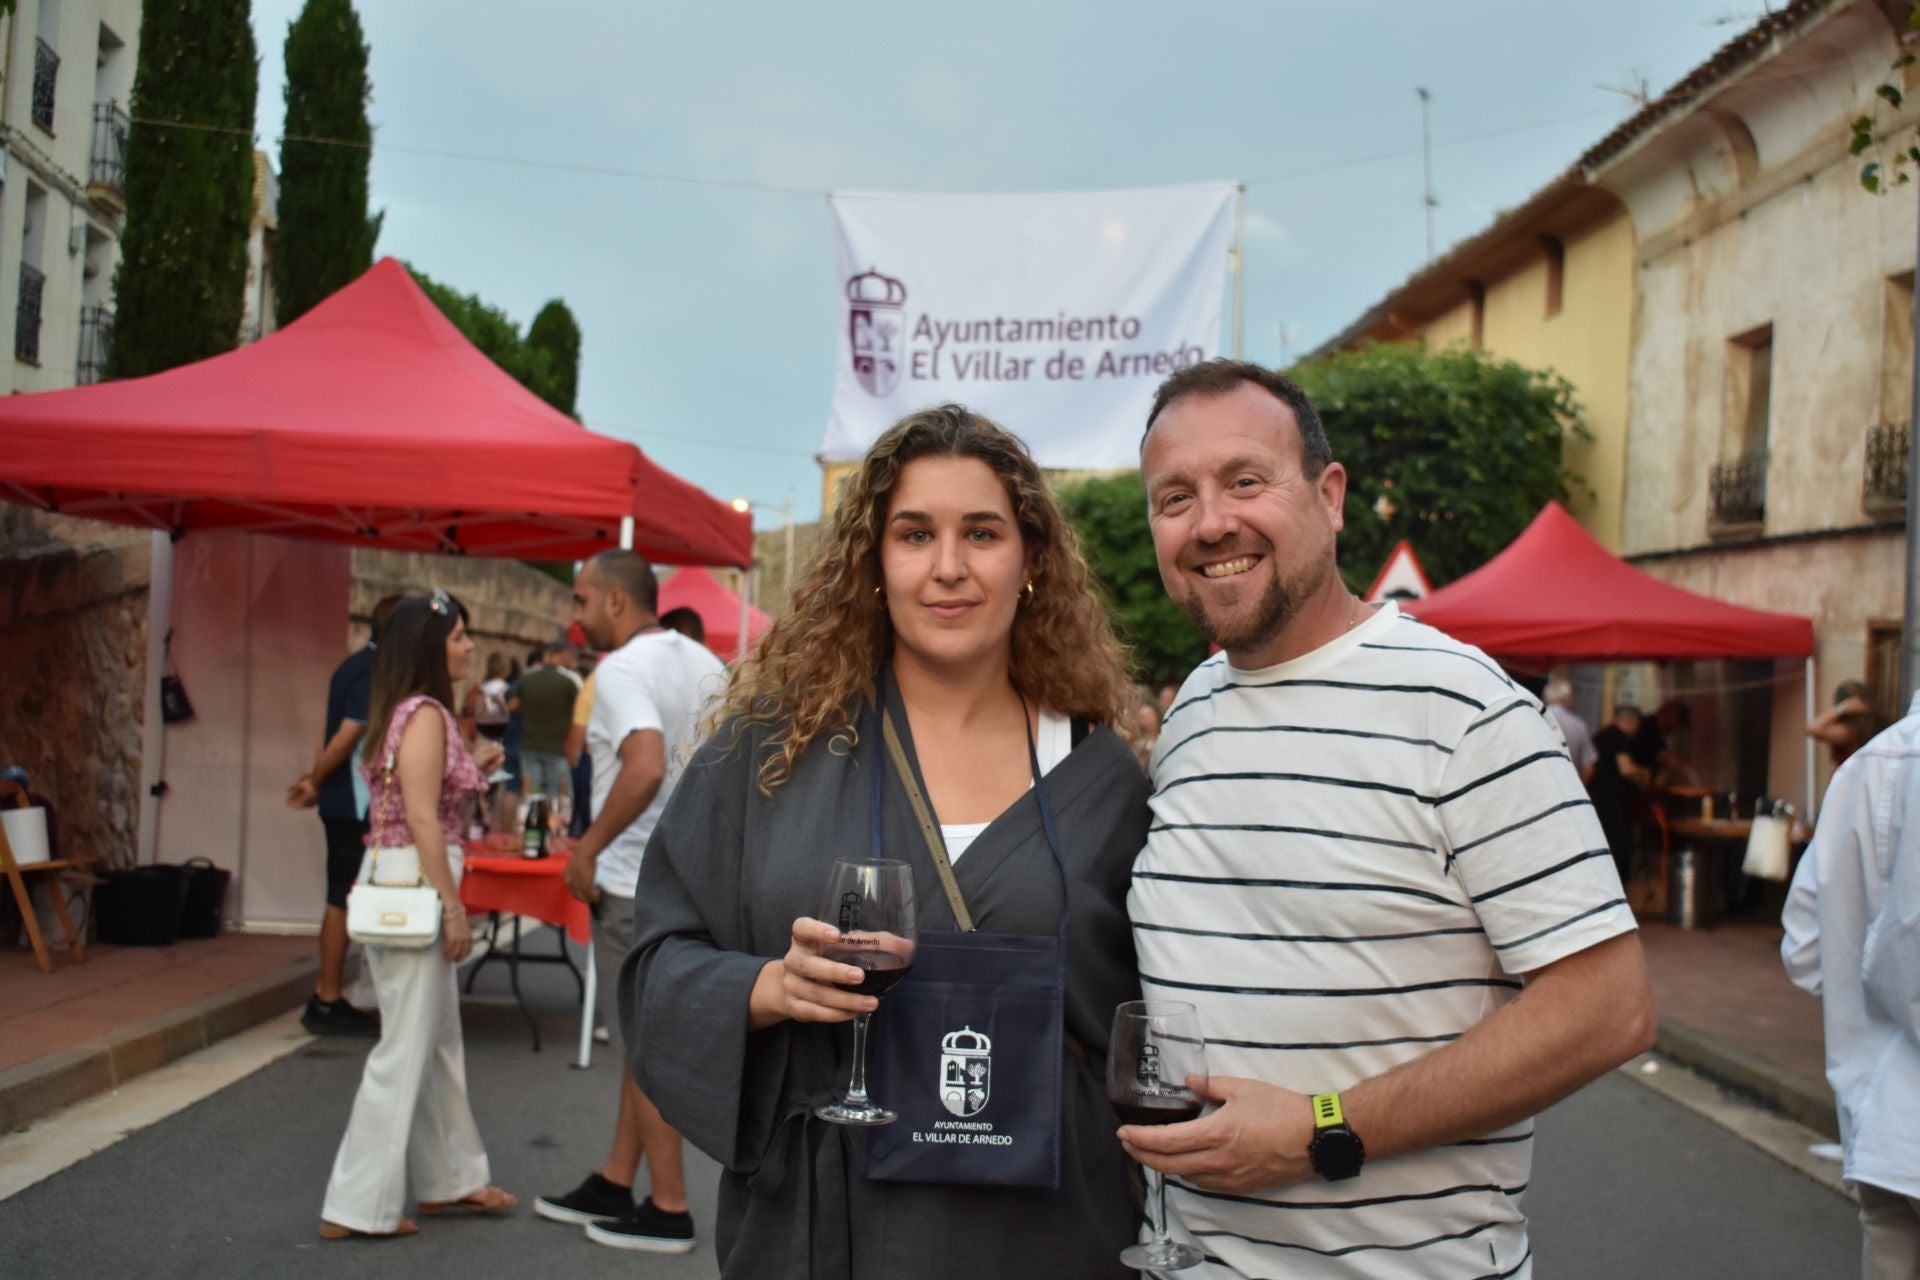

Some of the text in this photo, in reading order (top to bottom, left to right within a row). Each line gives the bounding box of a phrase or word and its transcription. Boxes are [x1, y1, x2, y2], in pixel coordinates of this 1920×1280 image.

[911, 312, 1141, 351] Ayuntamiento
[910, 338, 1204, 381] El Villar de Arnedo
[912, 1132, 1013, 1145] EL VILLAR DE ARNEDO
[934, 1120, 993, 1131] AYUNTAMIENTO
